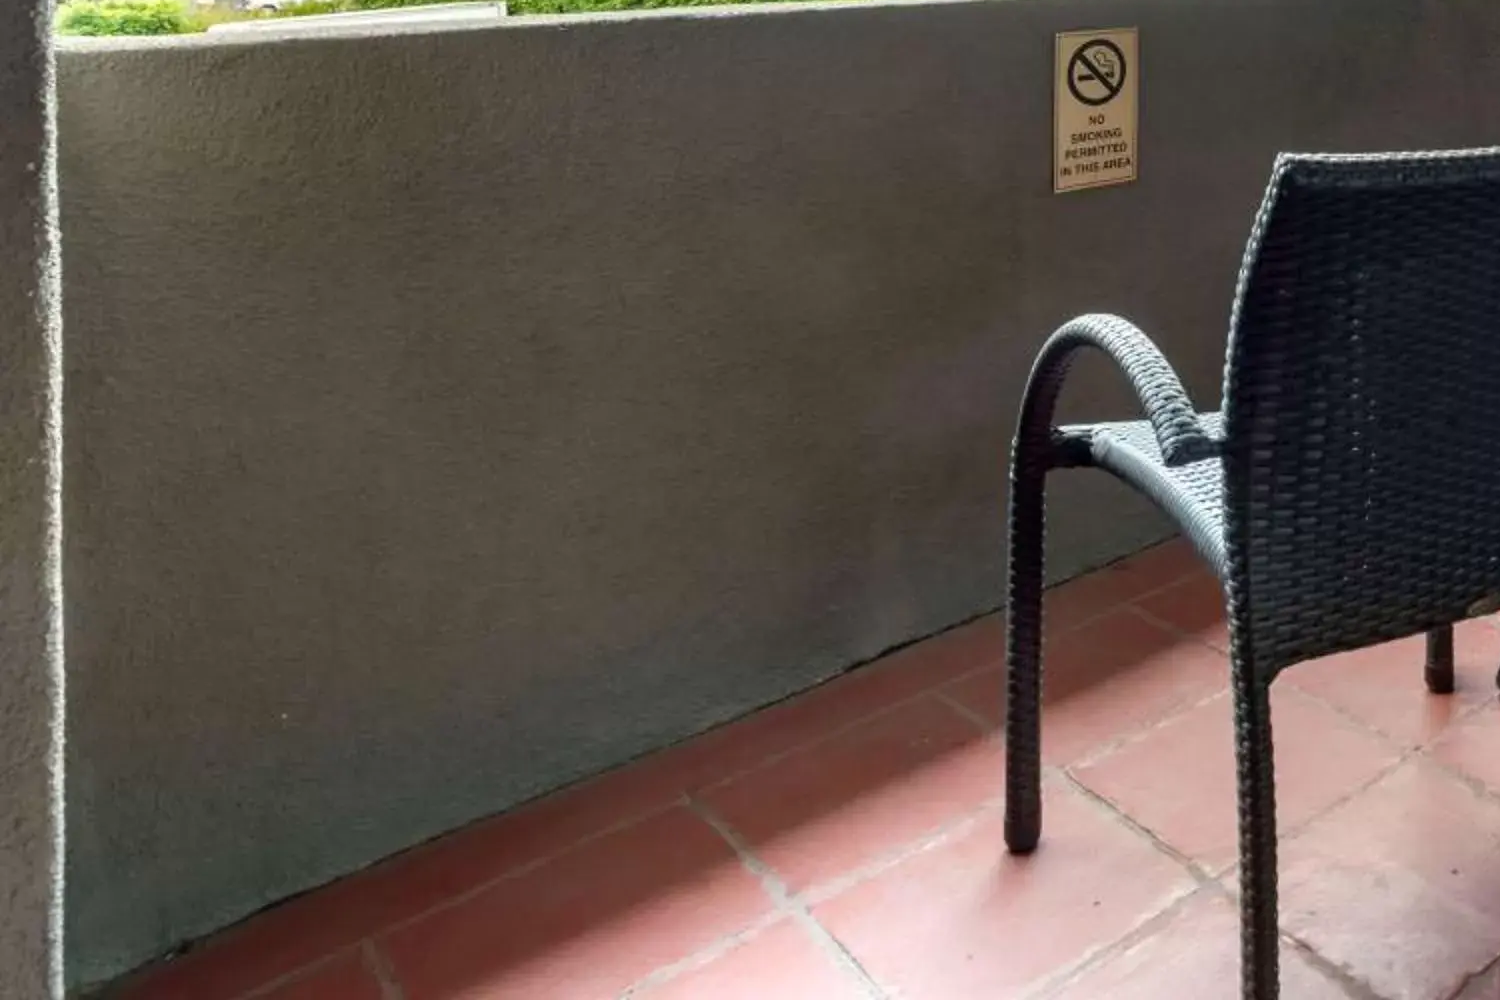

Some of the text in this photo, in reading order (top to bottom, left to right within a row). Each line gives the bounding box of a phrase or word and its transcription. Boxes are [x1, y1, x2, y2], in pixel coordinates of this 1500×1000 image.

[1088, 113, 1105, 126] NO
[1071, 127, 1122, 144] SMOKING
[1065, 142, 1127, 160] PERMITTED
[1060, 157, 1131, 176] IN THIS AREA
